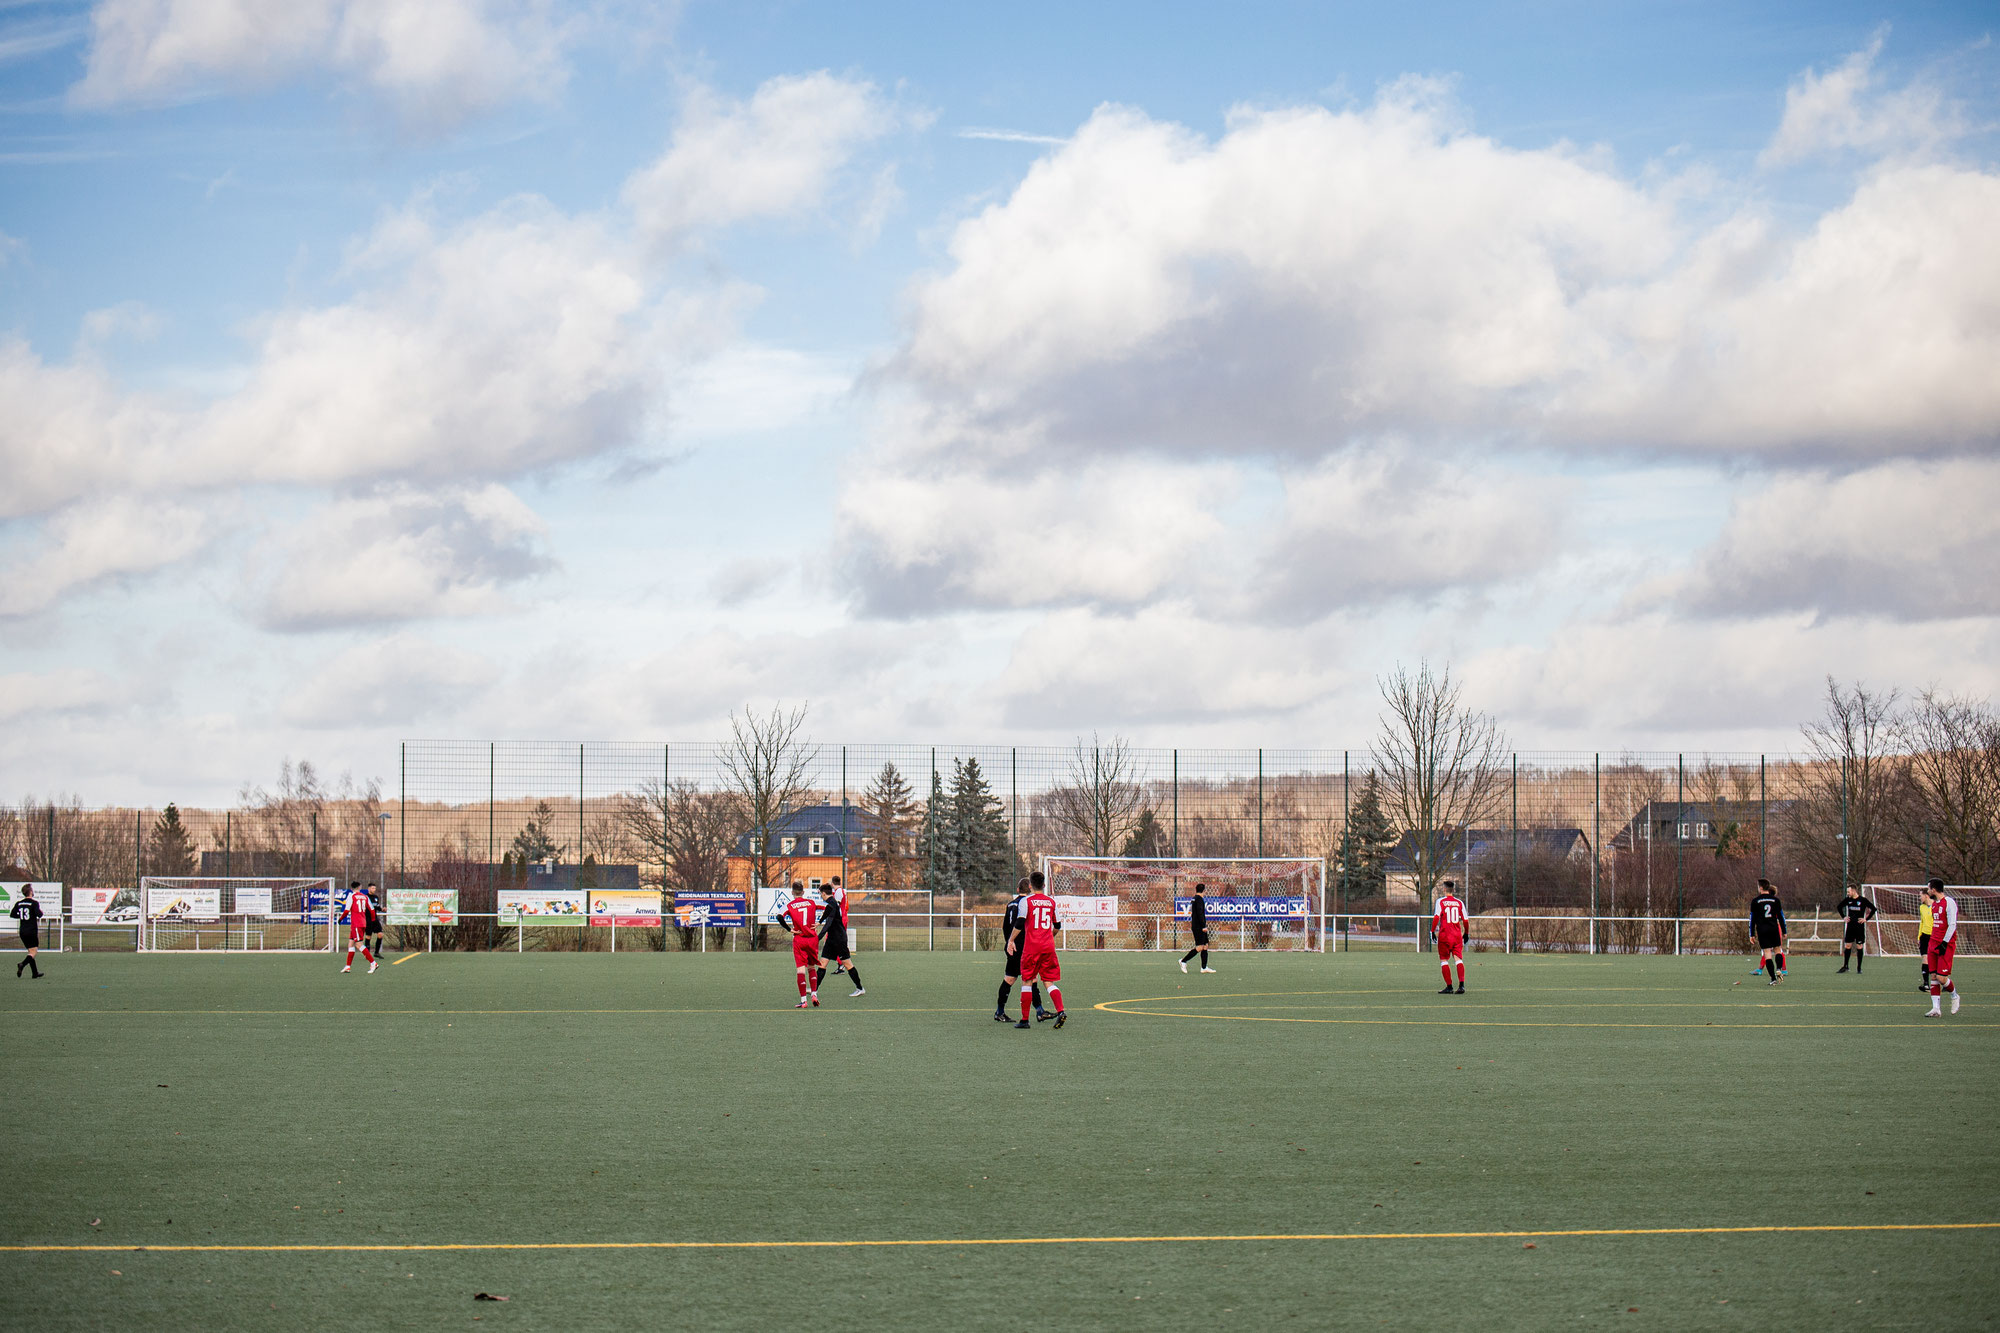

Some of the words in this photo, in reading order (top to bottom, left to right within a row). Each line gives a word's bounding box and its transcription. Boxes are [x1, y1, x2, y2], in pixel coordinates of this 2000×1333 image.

[18, 908, 30, 920] 13
[798, 907, 808, 926] 7
[1032, 907, 1051, 930] 15
[1444, 906, 1460, 924] 10
[1764, 904, 1772, 918] 2
